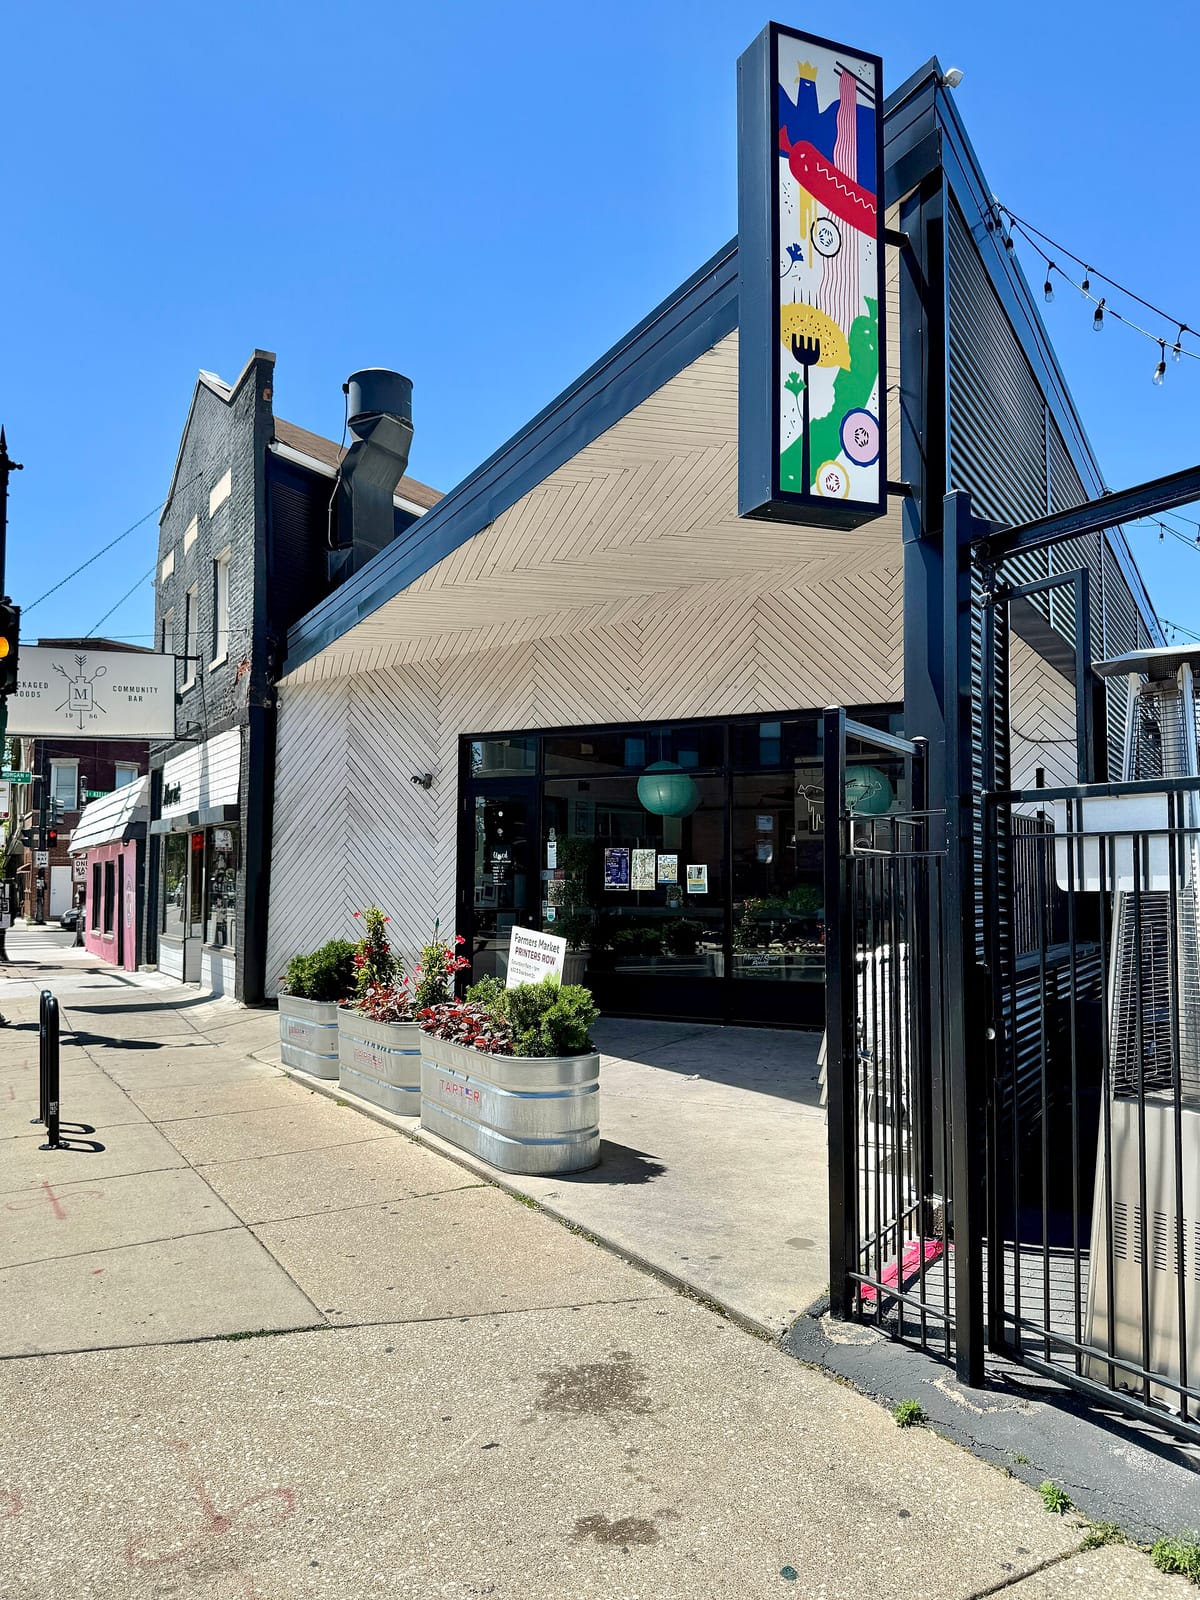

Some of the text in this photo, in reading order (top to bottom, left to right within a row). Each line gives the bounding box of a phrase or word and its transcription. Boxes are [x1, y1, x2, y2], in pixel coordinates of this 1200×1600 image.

[73, 688, 88, 700] M
[112, 685, 159, 694] COMMUNITY
[514, 932, 560, 954] Farmers Market
[515, 946, 541, 962] PRINTERS
[541, 954, 556, 966] ROW
[439, 1079, 480, 1102] TARTER
